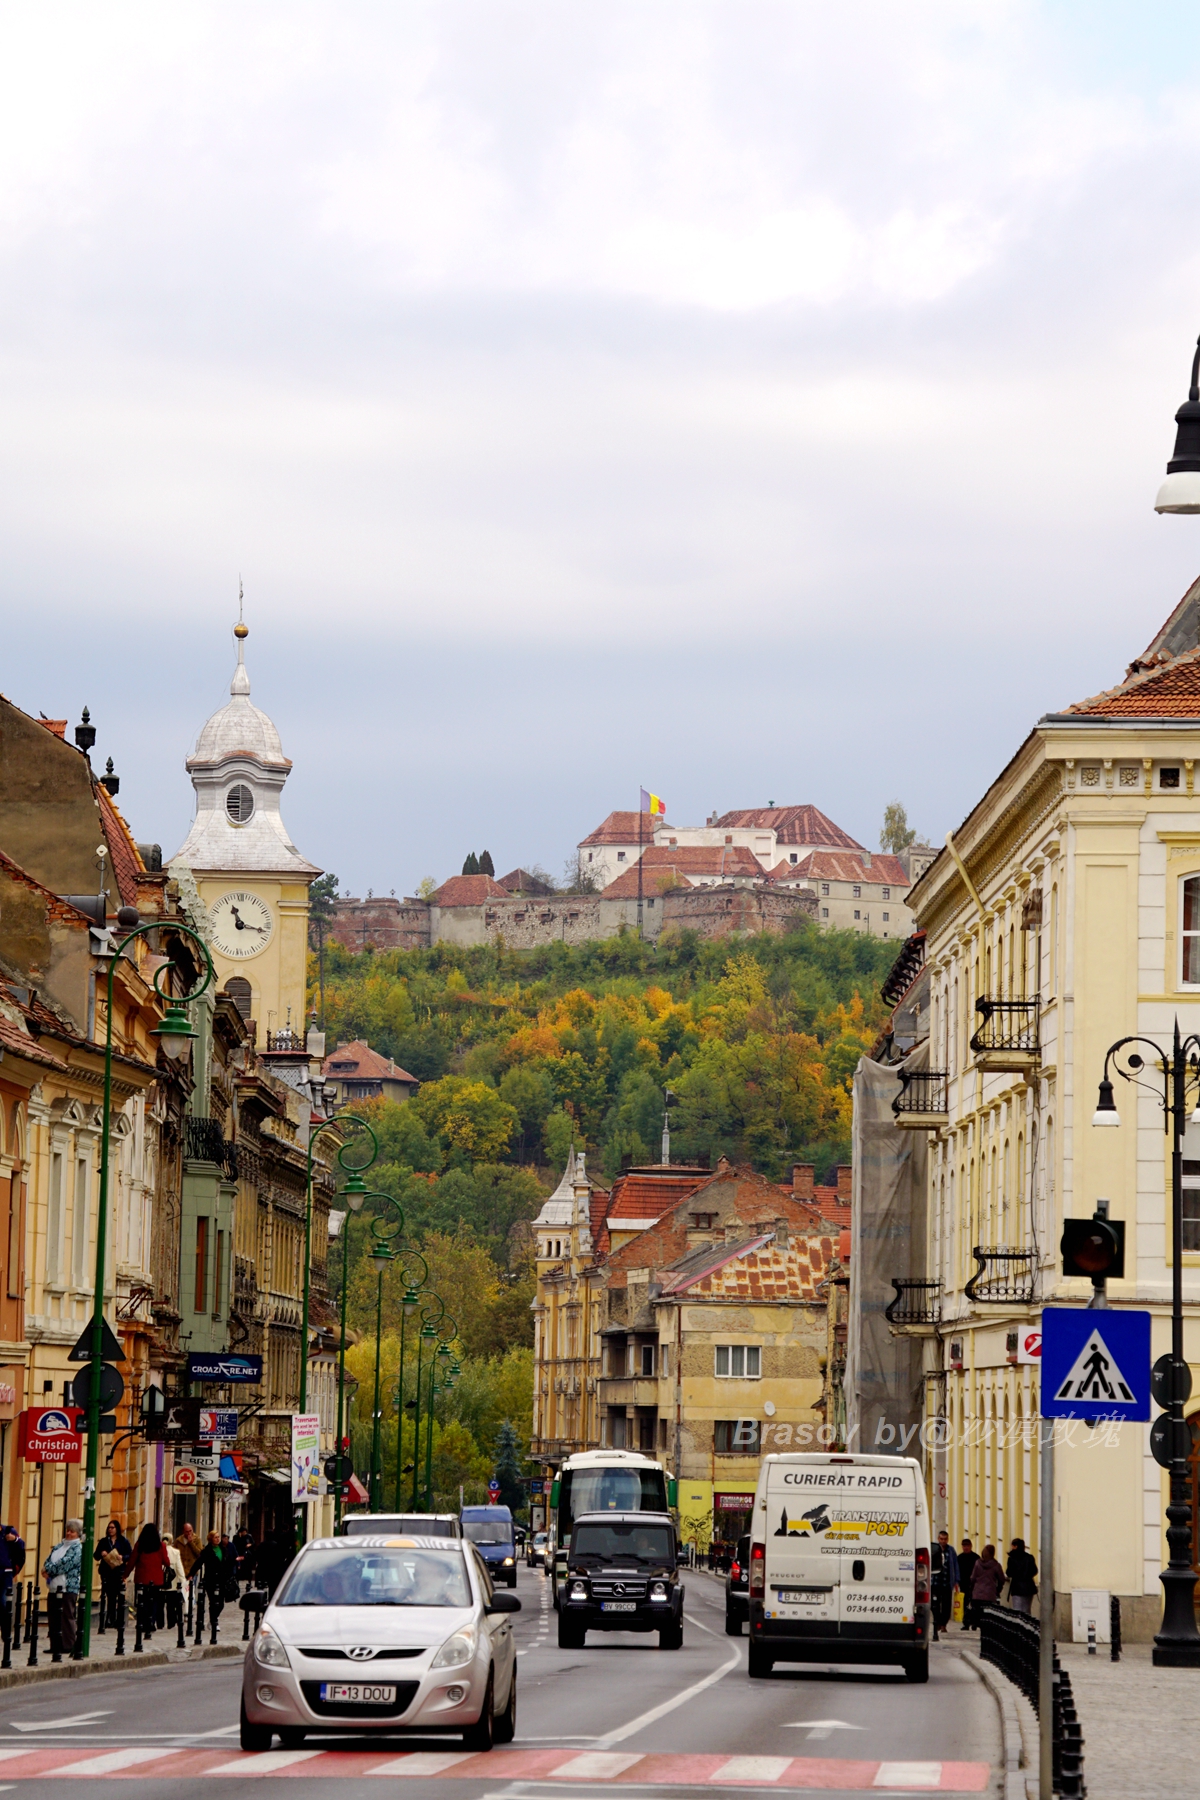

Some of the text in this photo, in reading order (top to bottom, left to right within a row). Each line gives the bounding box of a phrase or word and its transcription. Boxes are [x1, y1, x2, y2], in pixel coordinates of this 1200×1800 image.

[28, 1439, 78, 1450] Christian
[40, 1450, 65, 1460] Tour
[189, 1458, 214, 1466] BRD
[783, 1473, 903, 1488] CURIERAT RAPID
[831, 1510, 909, 1523] TRANSILVANIA
[866, 1521, 908, 1536] POST
[821, 1546, 913, 1557] www.transilvaniapost.ro
[784, 1593, 822, 1602] B 47 XPF
[846, 1593, 904, 1603] 0734-440.550
[846, 1605, 904, 1614] 0734-440.500
[363, 1687, 392, 1701] DOU
